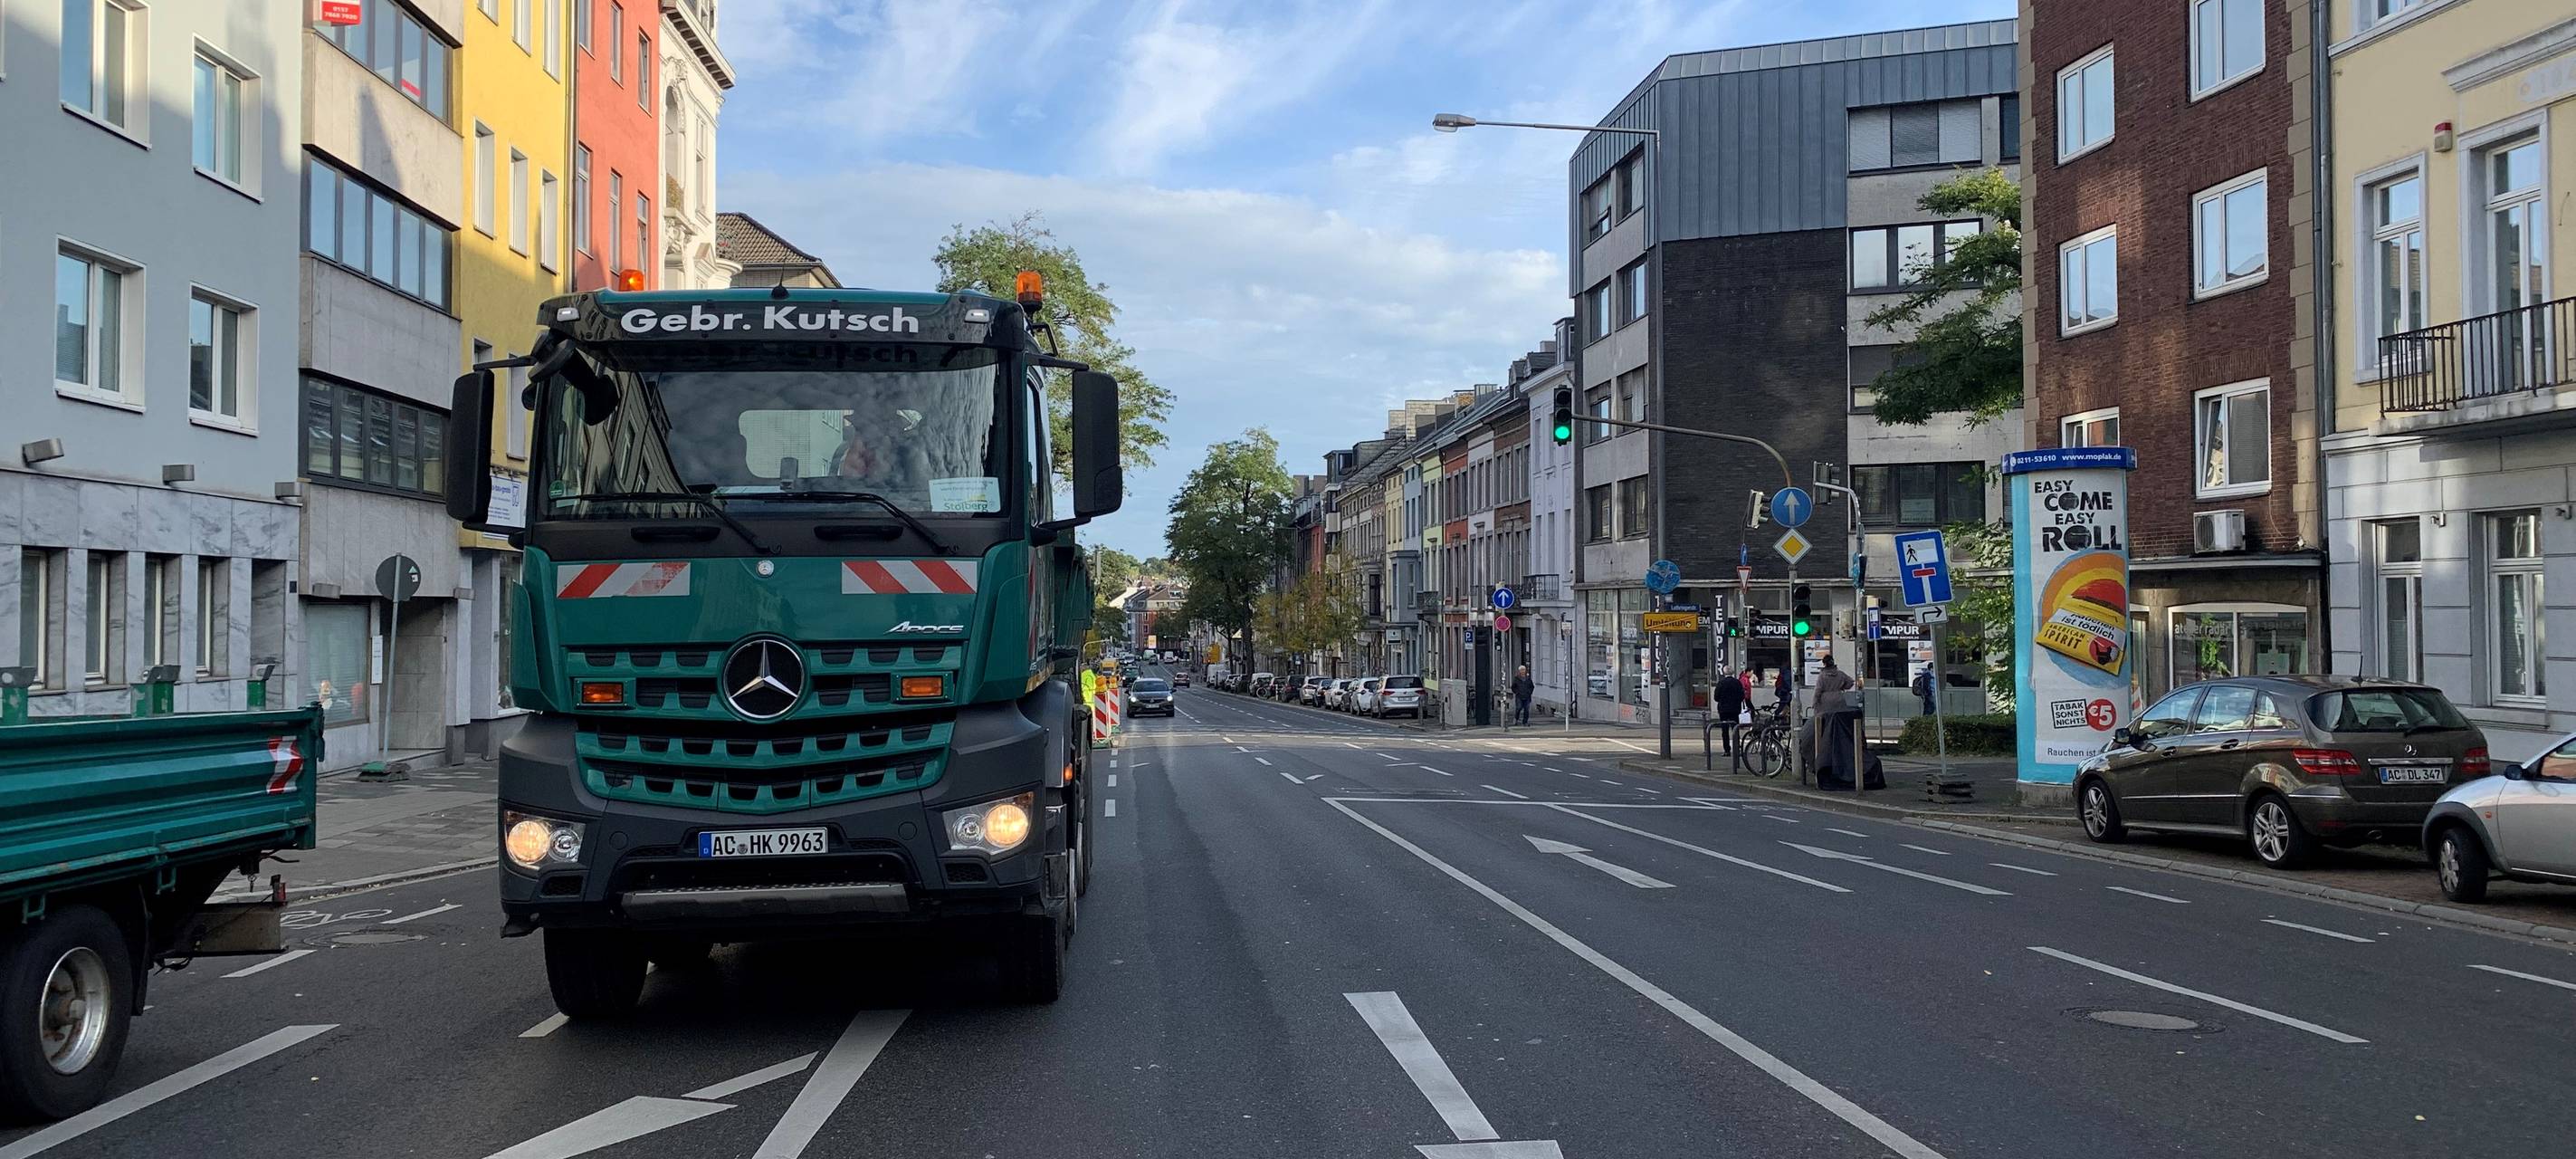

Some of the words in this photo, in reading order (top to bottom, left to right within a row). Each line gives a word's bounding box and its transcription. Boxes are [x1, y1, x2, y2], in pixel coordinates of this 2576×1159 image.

[620, 305, 751, 333] Gebr.
[763, 305, 919, 333] Kutsch
[2061, 454, 2122, 463] www.moplak.de
[2034, 479, 2074, 493] EASY
[944, 501, 988, 512] Stolberg
[2044, 492, 2113, 512] COME
[2055, 512, 2095, 525] EASY
[2042, 525, 2123, 552] ROLL
[2061, 616, 2076, 626] ist
[2078, 619, 2115, 641] tödlich
[2045, 628, 2082, 649] SPIRIT
[2055, 702, 2084, 711] TABAK
[2055, 709, 2085, 719] SONST
[2056, 717, 2086, 726] NICHTS
[2047, 747, 2085, 757] Rauchen
[2086, 749, 2096, 757] ist
[2388, 769, 2401, 781] AC
[2408, 769, 2421, 781] DL
[2422, 769, 2441, 781] 347
[712, 836, 736, 856] AC
[749, 834, 773, 855] HK
[778, 832, 824, 854] 9963
